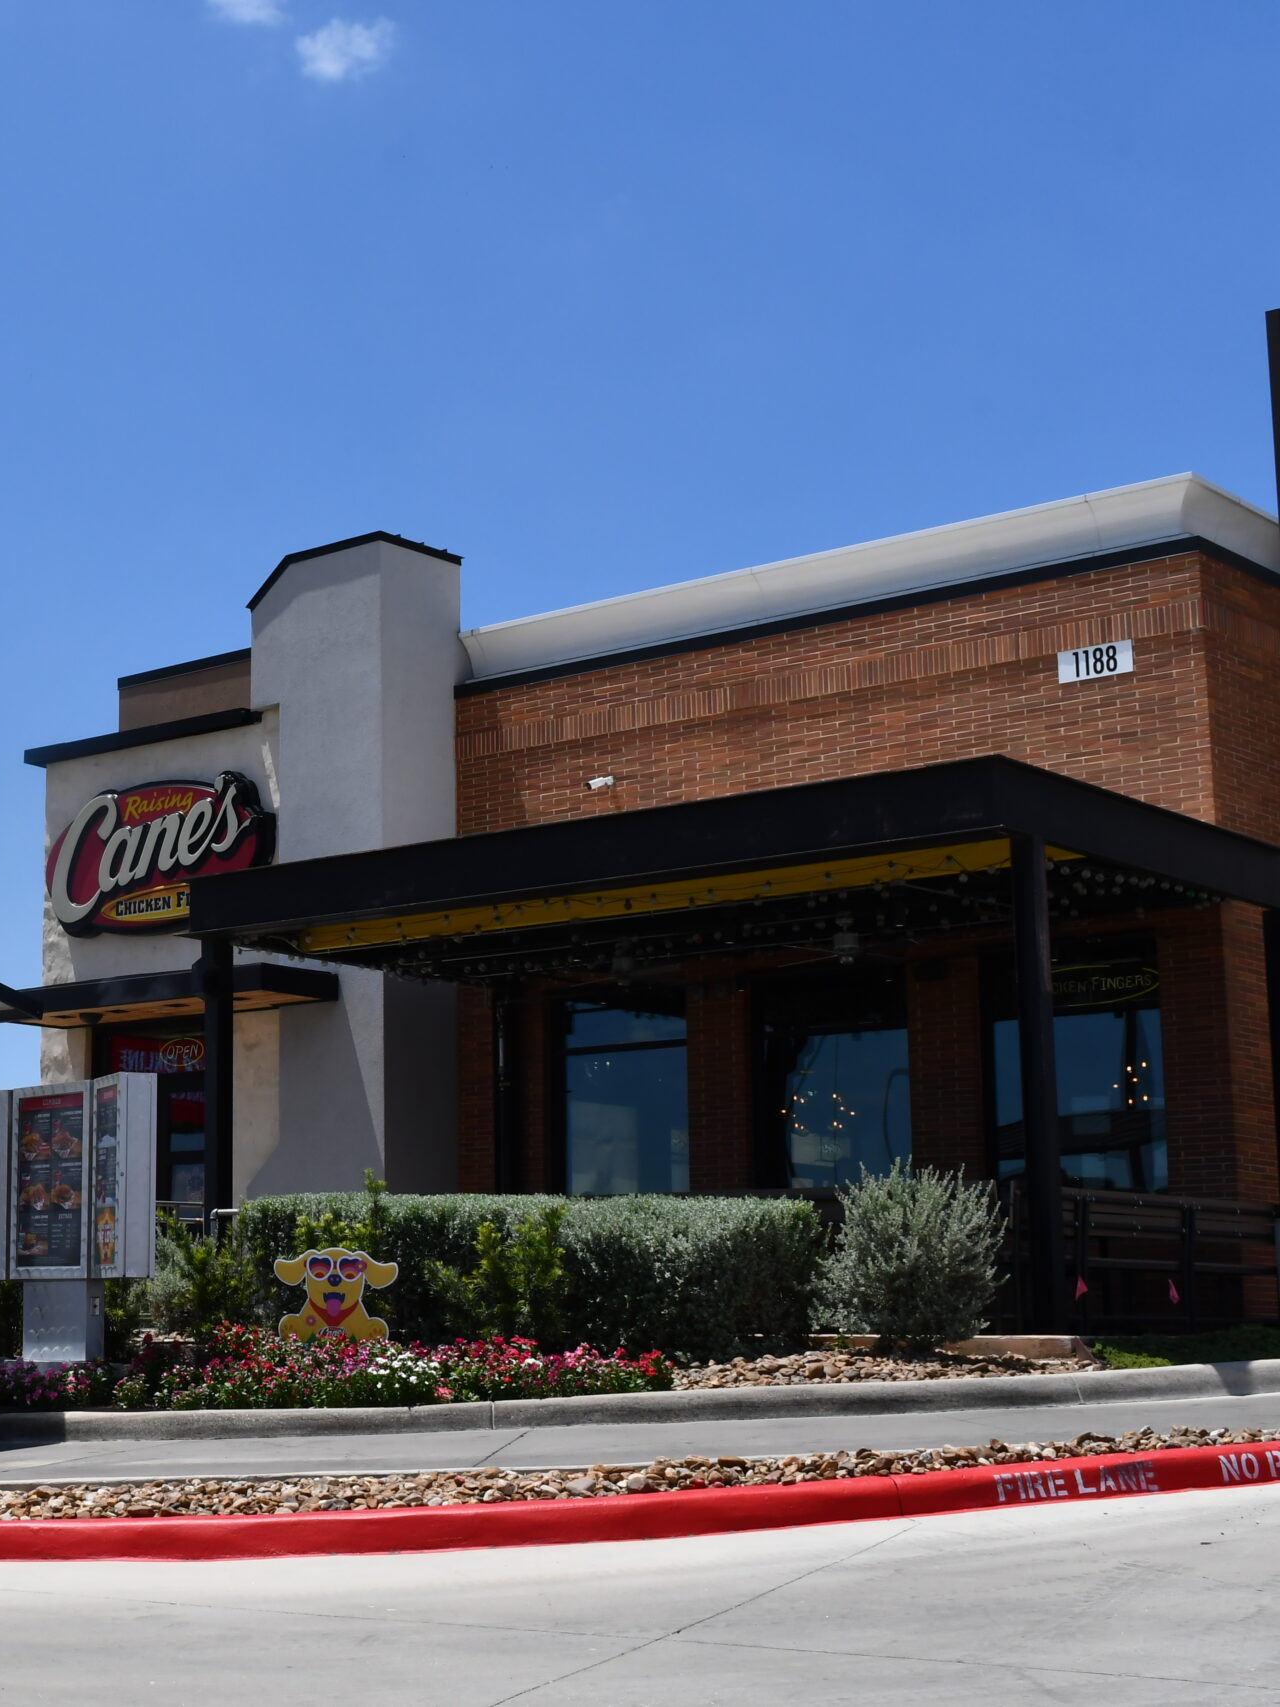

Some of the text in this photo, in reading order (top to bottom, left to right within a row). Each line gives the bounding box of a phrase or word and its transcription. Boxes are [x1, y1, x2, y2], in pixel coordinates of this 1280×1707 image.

[1072, 645, 1118, 678] 1188
[124, 791, 194, 821] Raising
[51, 775, 251, 923] Cane's
[115, 896, 172, 917] CHICKEN
[1090, 974, 1152, 992] FINGERS
[167, 1045, 199, 1060] OPEN
[993, 1470, 1068, 1502] FIRE
[1074, 1460, 1160, 1494] LANE
[1218, 1453, 1259, 1482] NO
